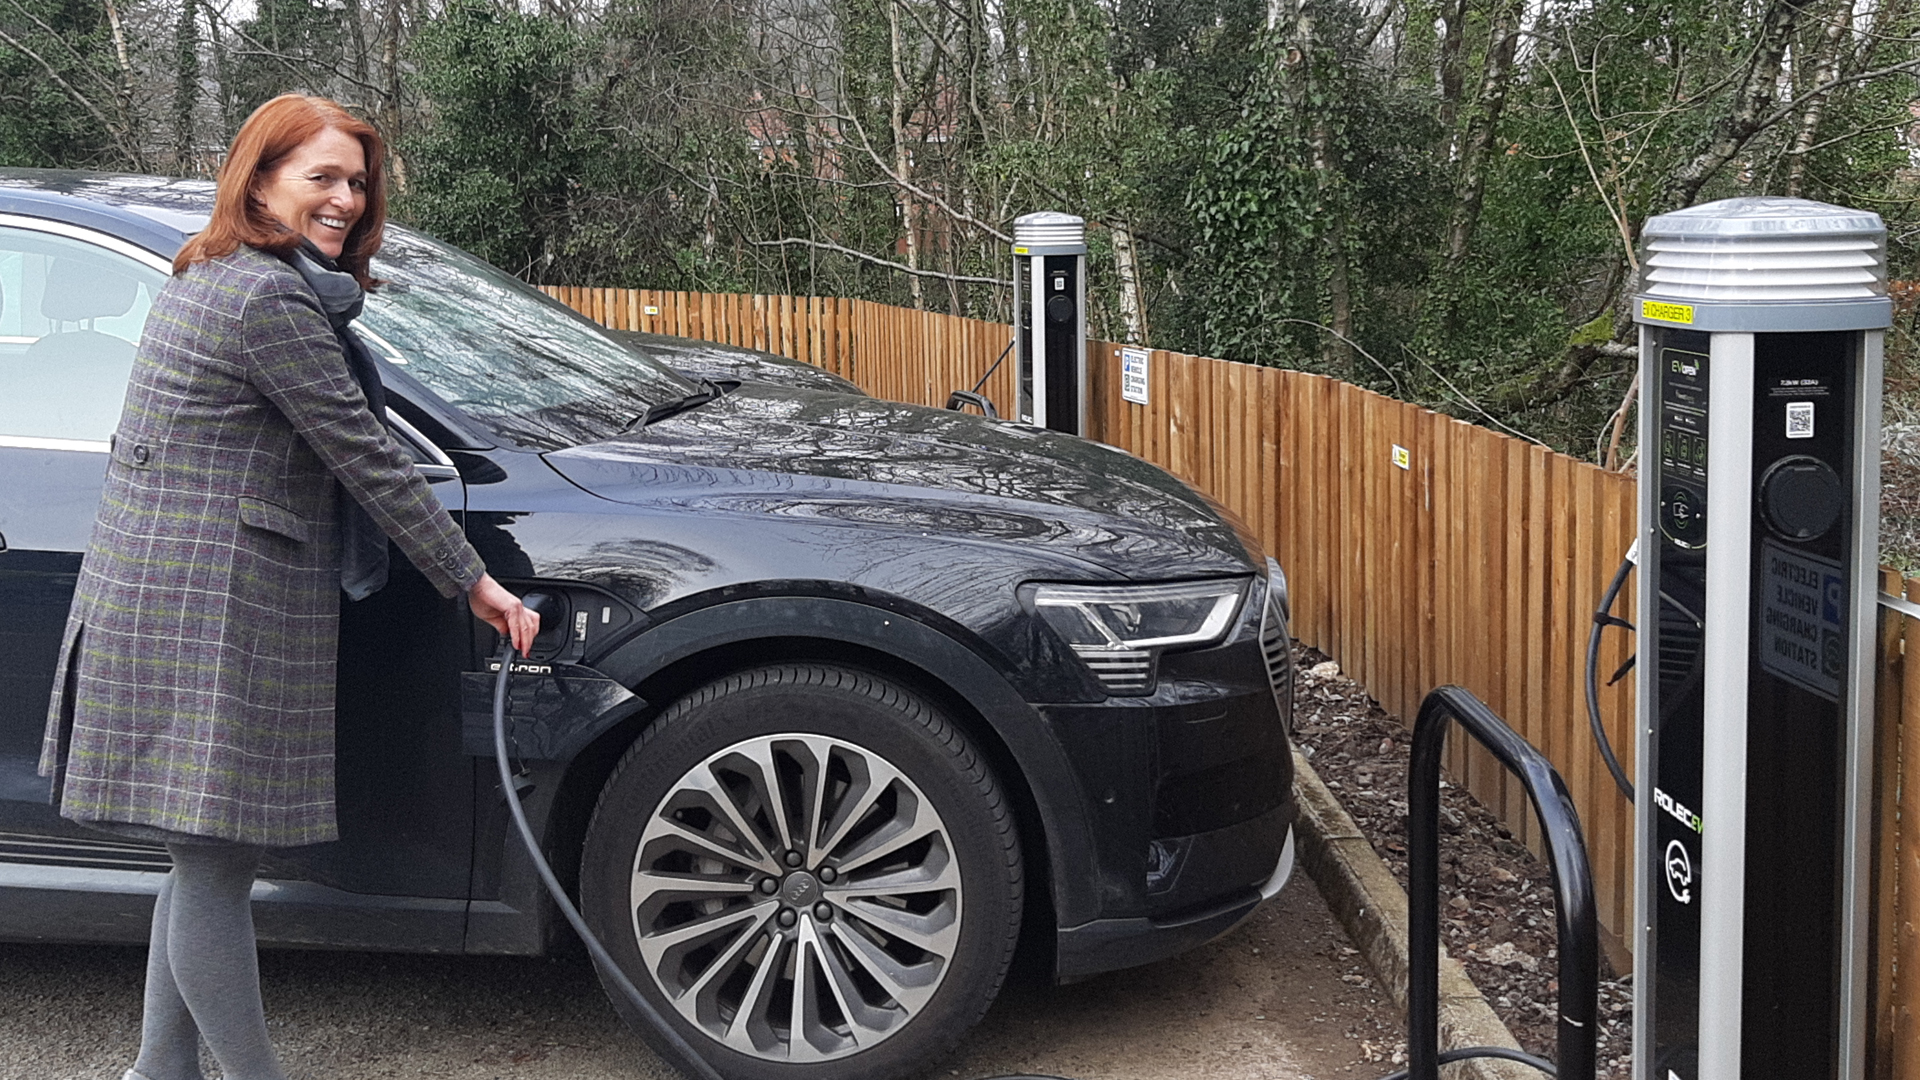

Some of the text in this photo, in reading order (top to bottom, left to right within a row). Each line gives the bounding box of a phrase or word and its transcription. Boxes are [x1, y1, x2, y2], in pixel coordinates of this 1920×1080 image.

[1650, 303, 1684, 320] CHARGER
[1685, 307, 1692, 322] 3
[490, 662, 551, 674] etron
